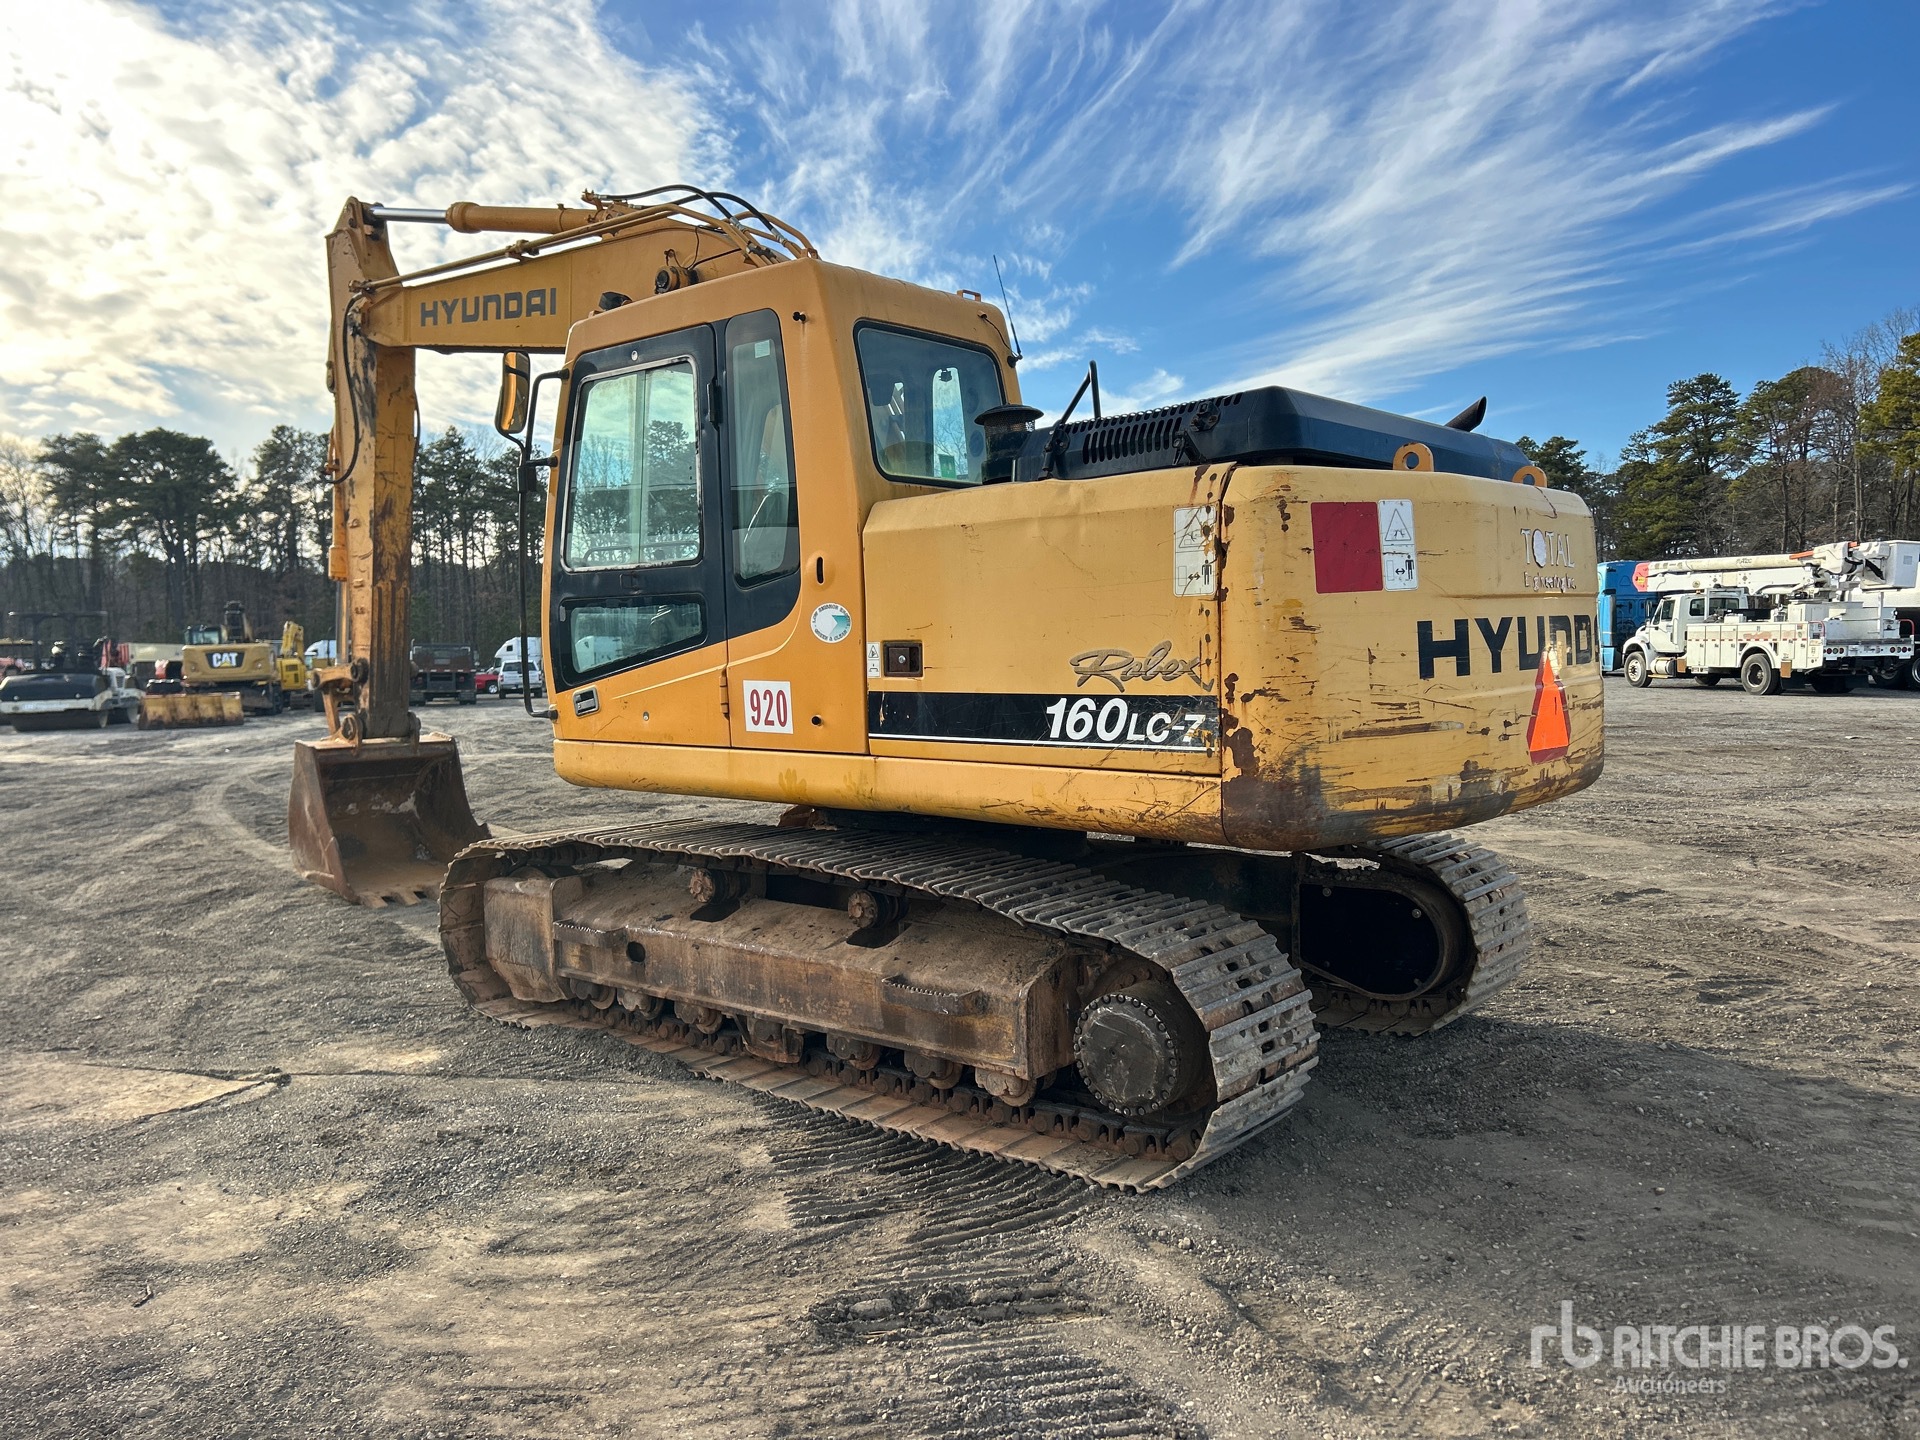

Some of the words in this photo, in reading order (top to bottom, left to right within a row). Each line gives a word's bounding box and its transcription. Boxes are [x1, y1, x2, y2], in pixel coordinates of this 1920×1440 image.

[421, 287, 557, 327] HYUNDAI
[212, 652, 238, 668] CAT
[1069, 640, 1214, 692] Robex
[1417, 614, 1599, 680] HYUND
[750, 689, 788, 728] 920
[1046, 697, 1206, 743] 160LC-7
